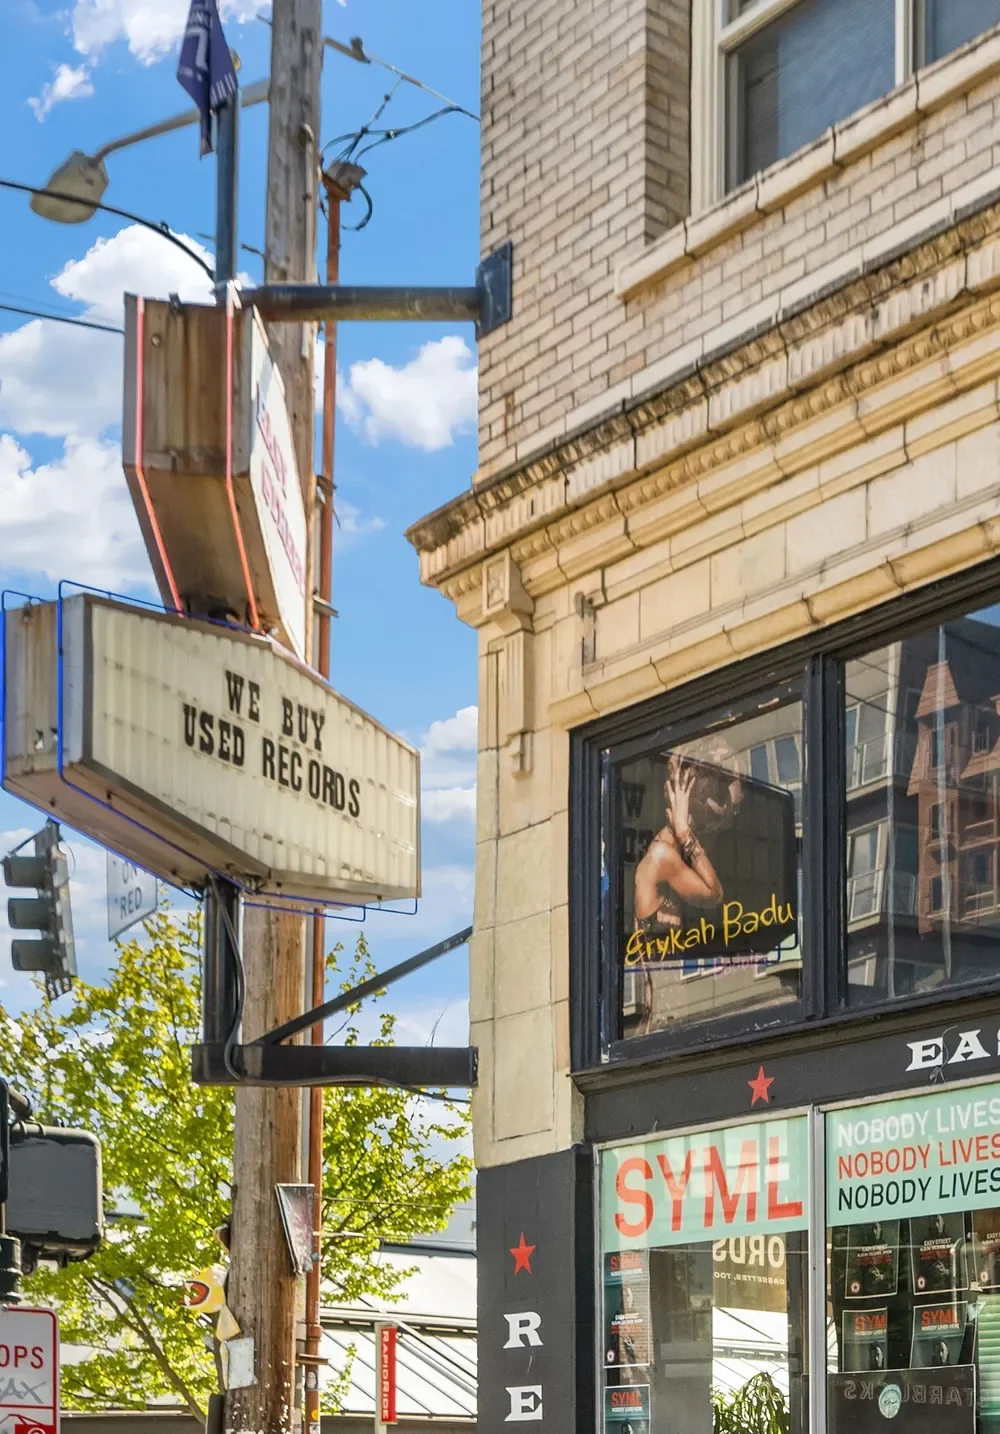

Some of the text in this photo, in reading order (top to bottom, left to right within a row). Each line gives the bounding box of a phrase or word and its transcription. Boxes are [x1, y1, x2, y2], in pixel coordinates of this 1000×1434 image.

[225, 668, 326, 751] WE BUY
[183, 703, 361, 818] USED RECORDS
[120, 887, 143, 919] RED
[624, 893, 795, 966] Erykah Badu
[838, 1110, 930, 1149] NOBODY
[838, 1143, 931, 1180] NOBODY
[613, 1135, 804, 1238] SYML
[838, 1176, 932, 1211] NOBODY
[921, 1308, 960, 1326] SYML
[381, 1330, 389, 1419] RAPIDRIDE
[611, 1391, 643, 1407] SYML
